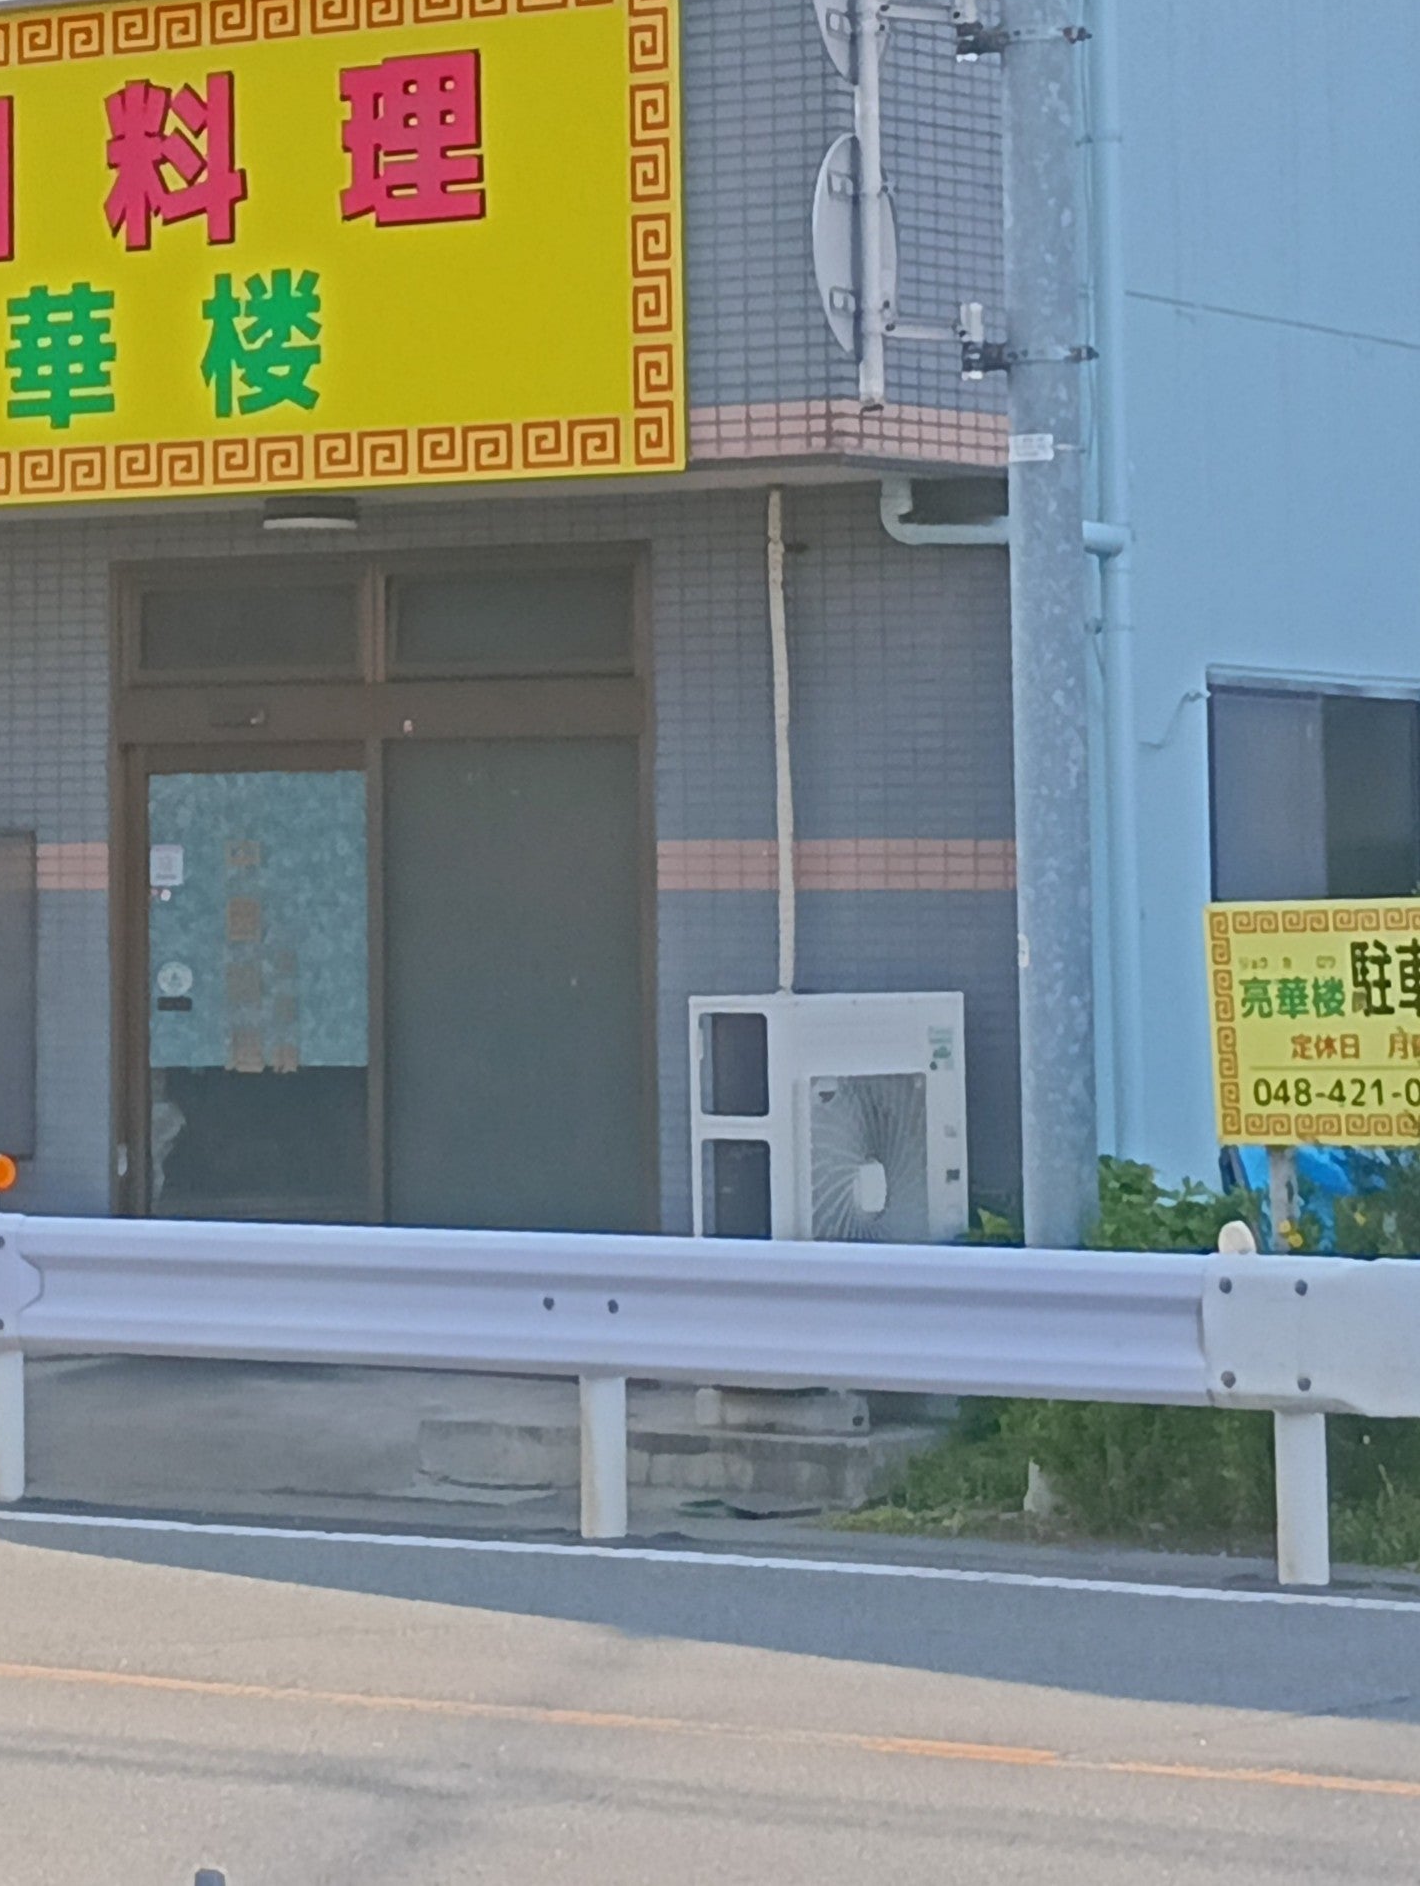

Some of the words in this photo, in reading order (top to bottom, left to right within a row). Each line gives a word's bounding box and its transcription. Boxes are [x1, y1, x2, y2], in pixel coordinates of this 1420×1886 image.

[1238, 975, 1346, 1019] 亮華楼
[1290, 1033, 1361, 1060] 定休日
